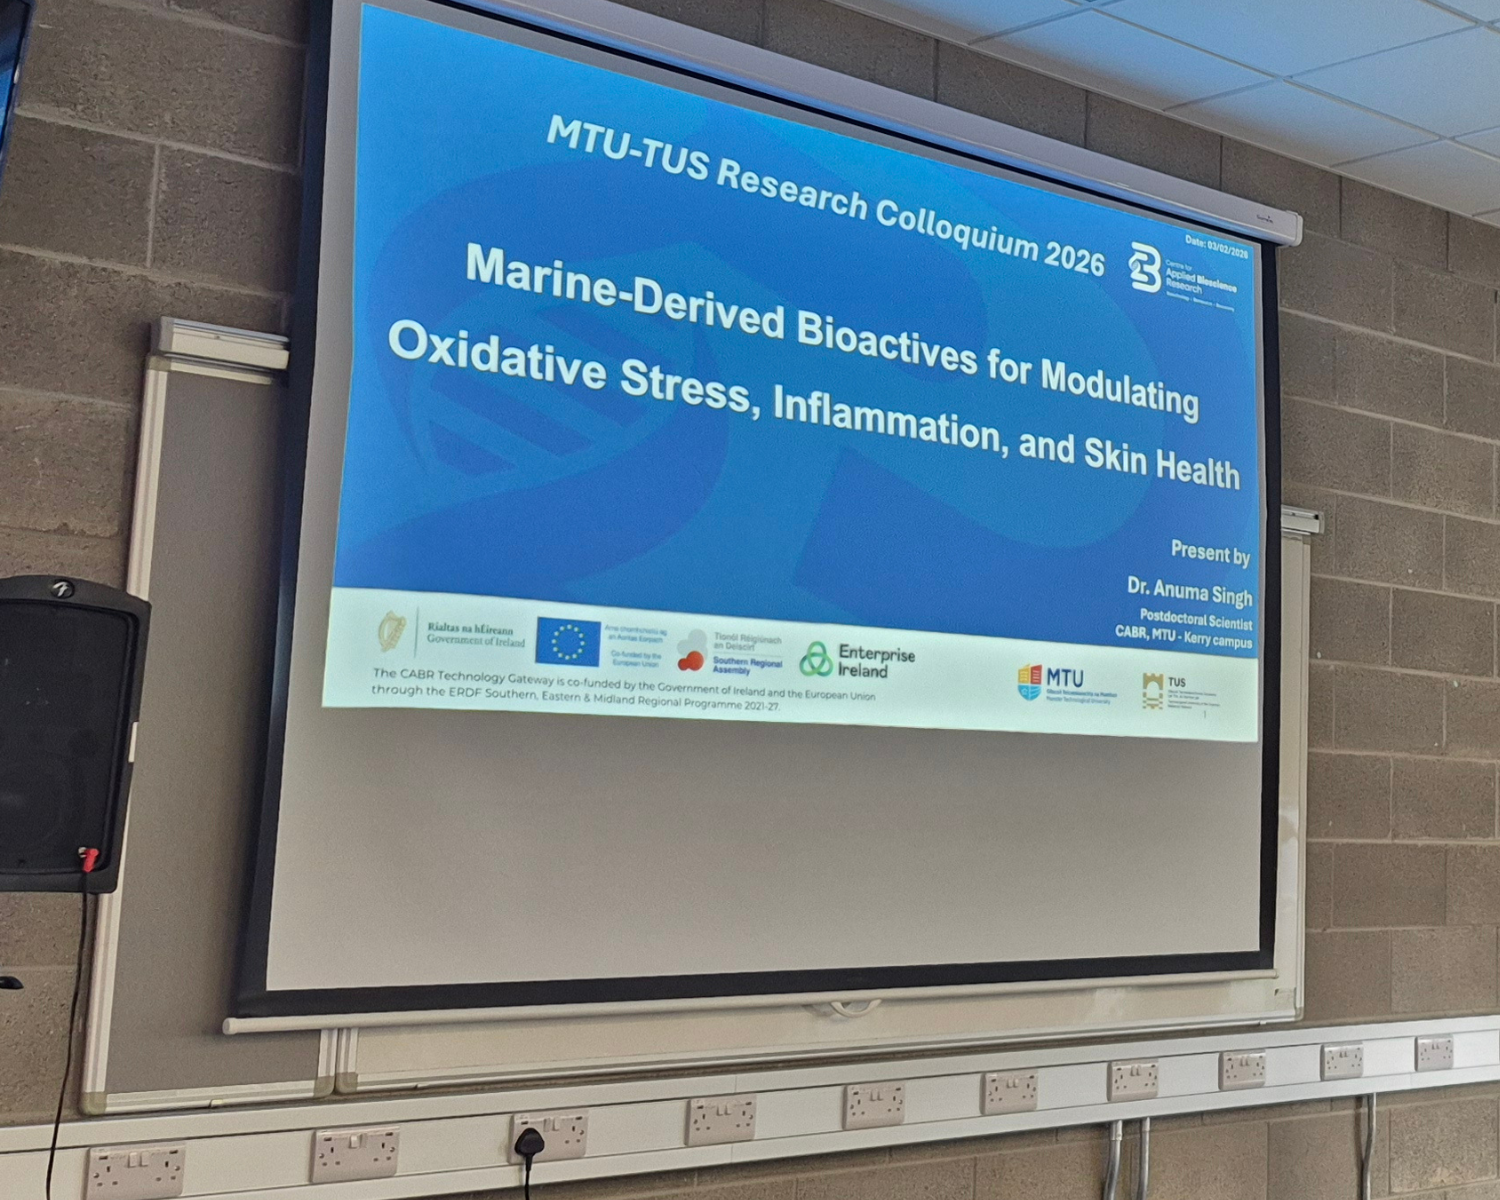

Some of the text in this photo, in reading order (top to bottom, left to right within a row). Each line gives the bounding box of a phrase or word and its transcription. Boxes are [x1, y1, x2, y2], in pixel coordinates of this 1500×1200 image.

[548, 115, 1105, 277] MTU-TUS Research Colloquium 2026
[1185, 234, 1206, 249] Date:
[1166, 267, 1197, 283] Applied
[1166, 277, 1203, 295] Research
[466, 242, 1199, 425] Marine-Derived Bioactives for Modulating
[388, 319, 1241, 491] Oxidative Stress, Inflammation, and Skin Health
[1171, 539, 1251, 570] Present by
[1127, 575, 1253, 610] Dr. Anuma Singh
[1140, 608, 1253, 631] Postdoctoral Scientist
[427, 633, 526, 648] Government of Ireland
[1115, 625, 1253, 651] CABR, MTU Kerry campus
[713, 656, 783, 669] Southern Regional
[838, 643, 916, 665] Enterprise
[713, 665, 750, 677] Assembly
[838, 662, 889, 679] Ireland
[1046, 667, 1085, 688] MTU
[373, 667, 876, 702] The CABR Technology Gateway is co-funded by the Government of Ireland and the European Union
[1168, 676, 1186, 688] TUS
[372, 684, 423, 698] through
[426, 686, 446, 697] the
[449, 687, 482, 697] ERDF
[541, 691, 582, 702] Eastern
[583, 693, 591, 703] &
[594, 694, 636, 705] Midland
[638, 695, 682, 708] Regional
[685, 697, 743, 710] Programme
[744, 701, 781, 712] 2021-27.
